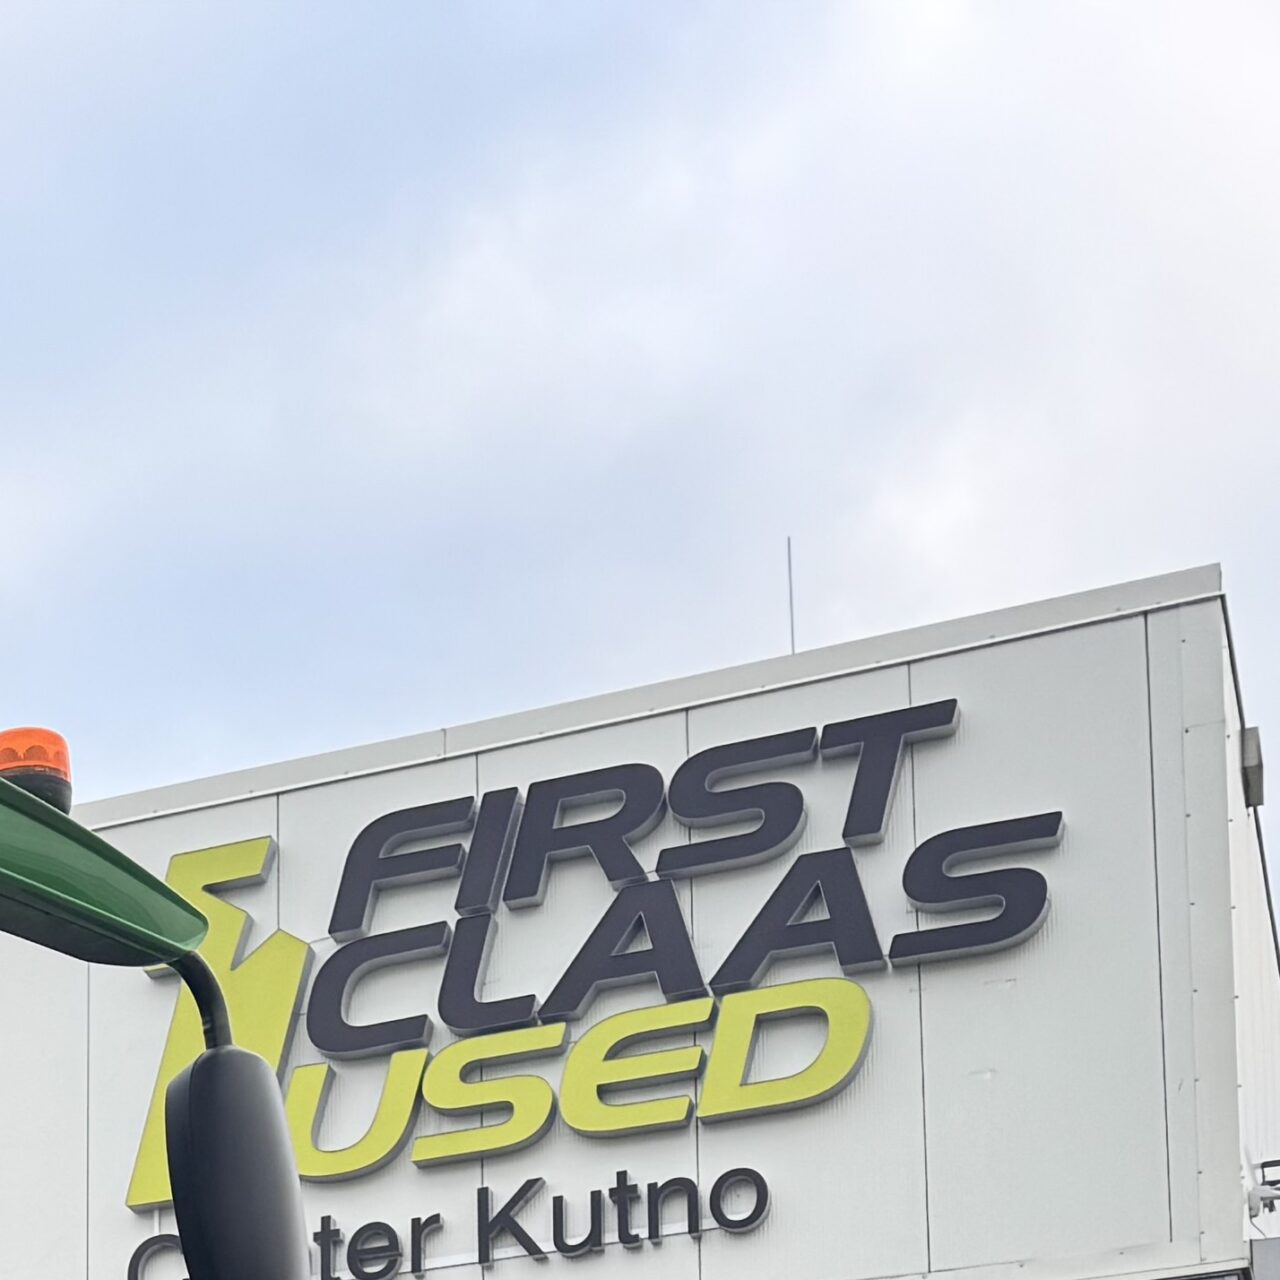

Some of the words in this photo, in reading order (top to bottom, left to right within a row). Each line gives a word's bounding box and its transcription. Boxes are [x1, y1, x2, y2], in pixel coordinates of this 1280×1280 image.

[328, 697, 962, 942] FIRST
[306, 810, 1065, 1061] CLAAS
[283, 976, 874, 1183] USED
[477, 1165, 771, 1265] Kutno
